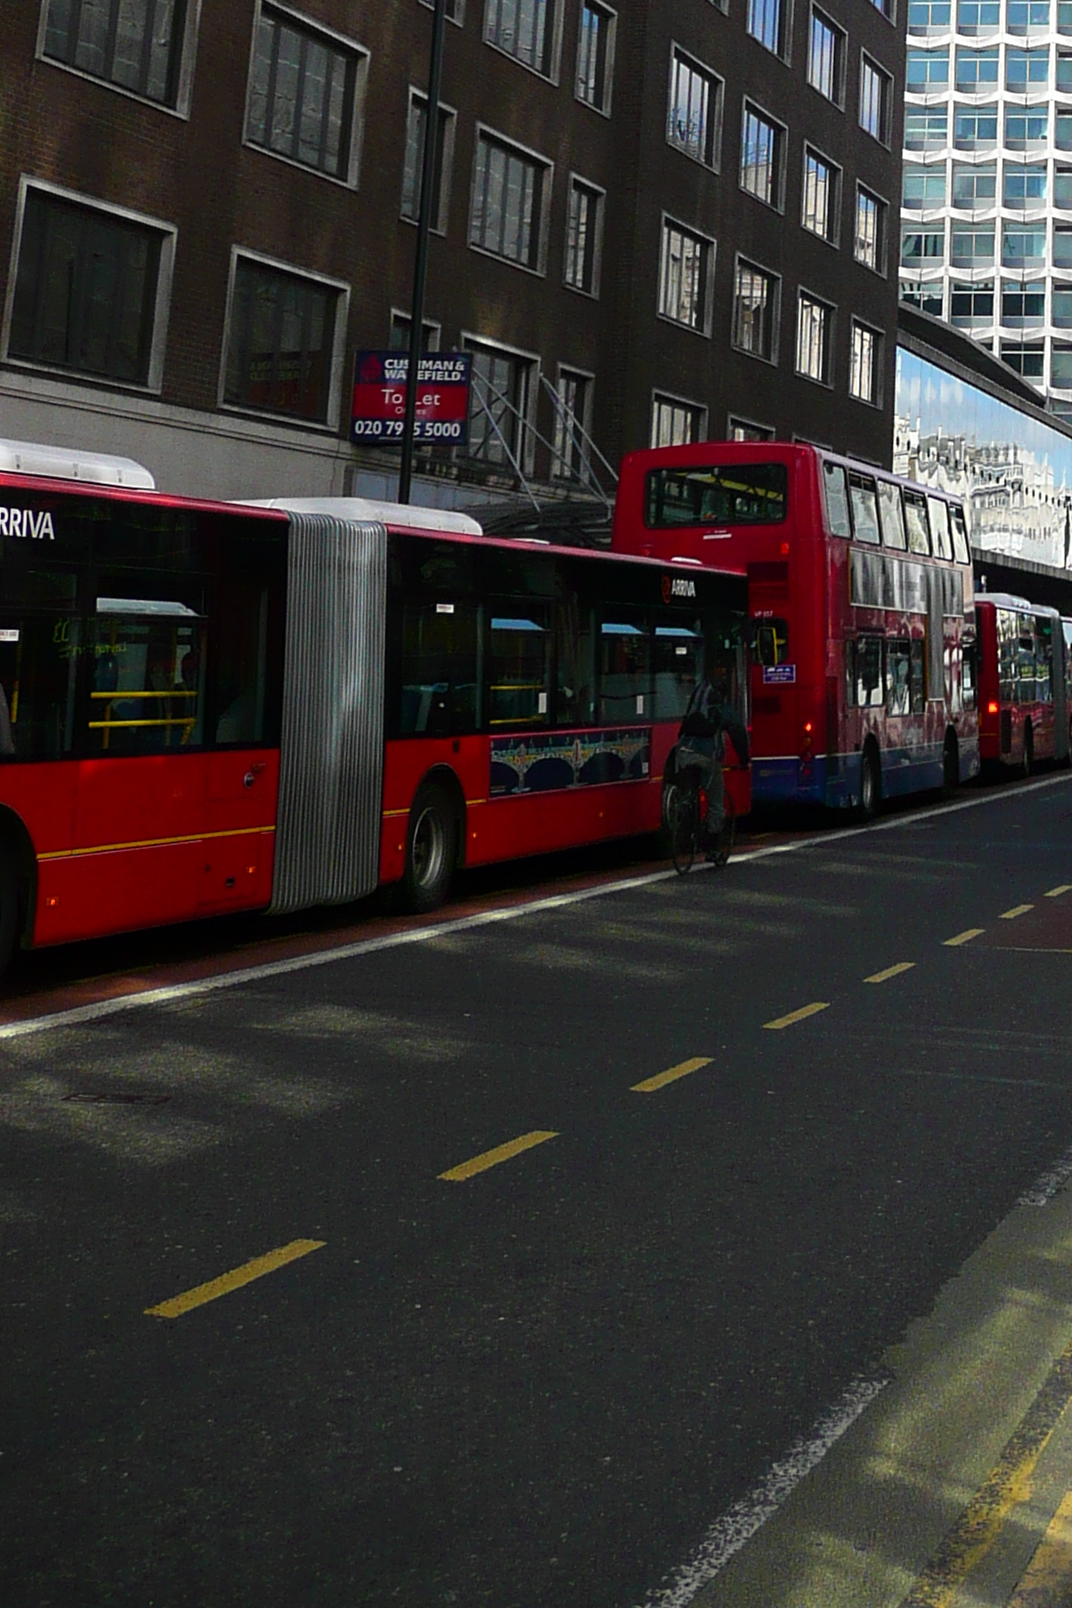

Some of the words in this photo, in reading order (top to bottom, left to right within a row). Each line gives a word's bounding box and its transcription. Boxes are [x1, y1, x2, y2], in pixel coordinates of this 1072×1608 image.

[384, 358, 453, 371] CUSMAN
[384, 370, 461, 381] WAEFIELD
[381, 389, 403, 405] To
[355, 420, 382, 435] 020
[385, 421, 421, 436] 795
[424, 422, 460, 437] 5000
[671, 578, 697, 598] ARRIVA
